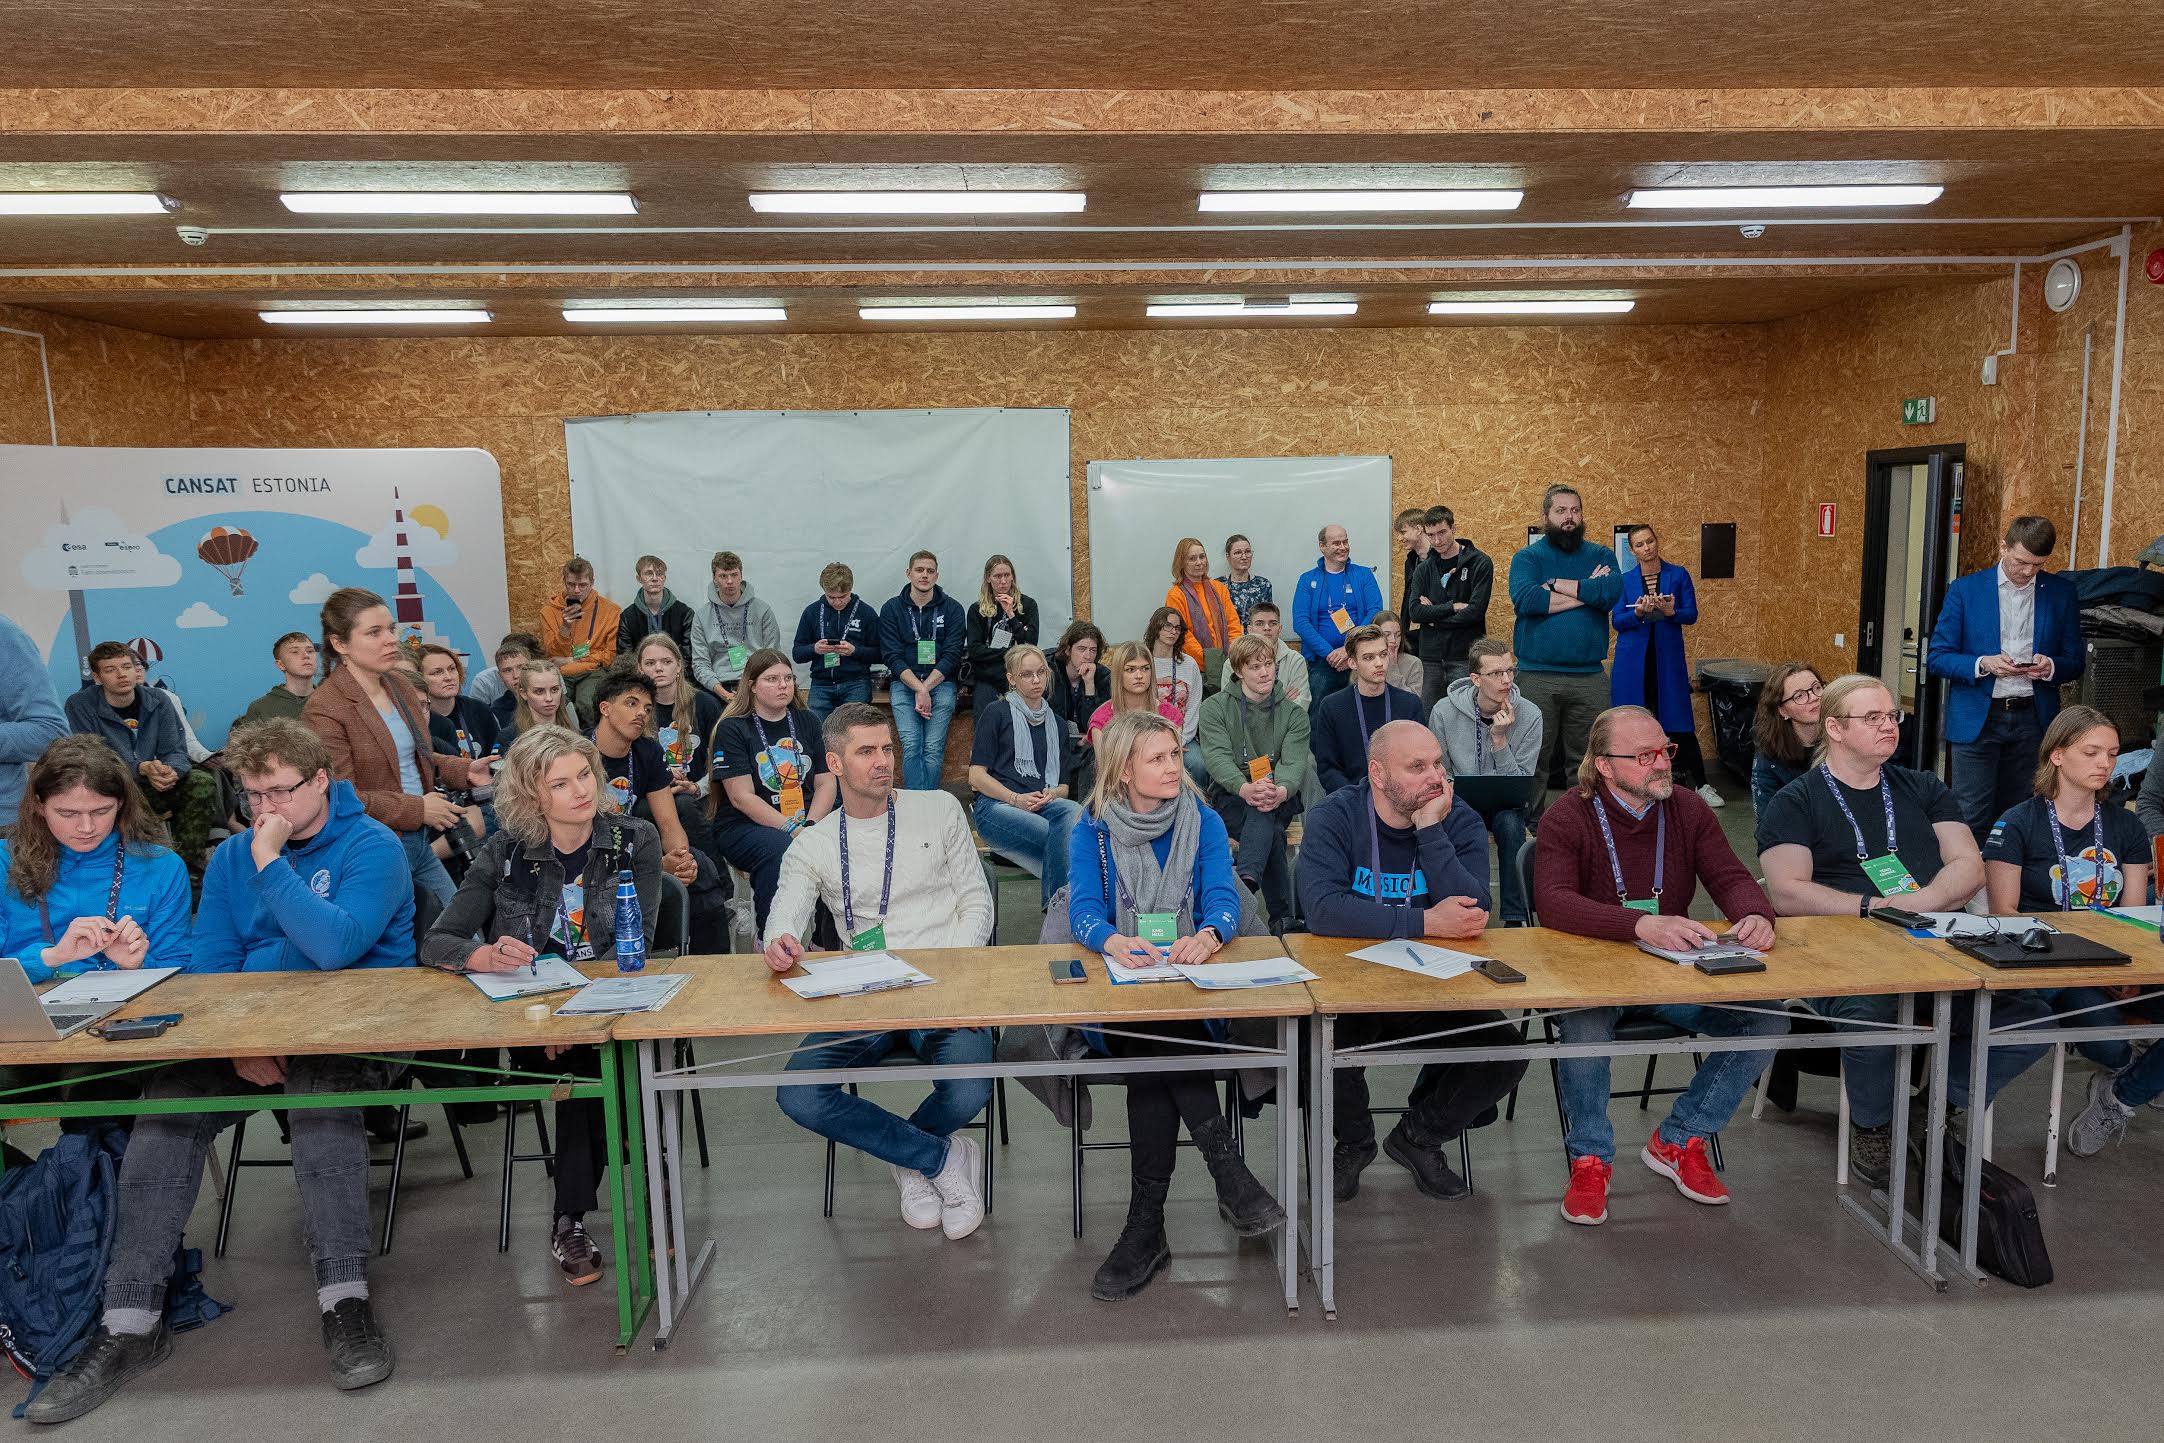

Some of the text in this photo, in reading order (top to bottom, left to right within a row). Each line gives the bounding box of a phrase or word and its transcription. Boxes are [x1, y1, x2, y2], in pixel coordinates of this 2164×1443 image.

[165, 477, 332, 494] CANSAT ESTONIA
[1357, 870, 1417, 893] MSIO
[576, 948, 592, 958] ANS
